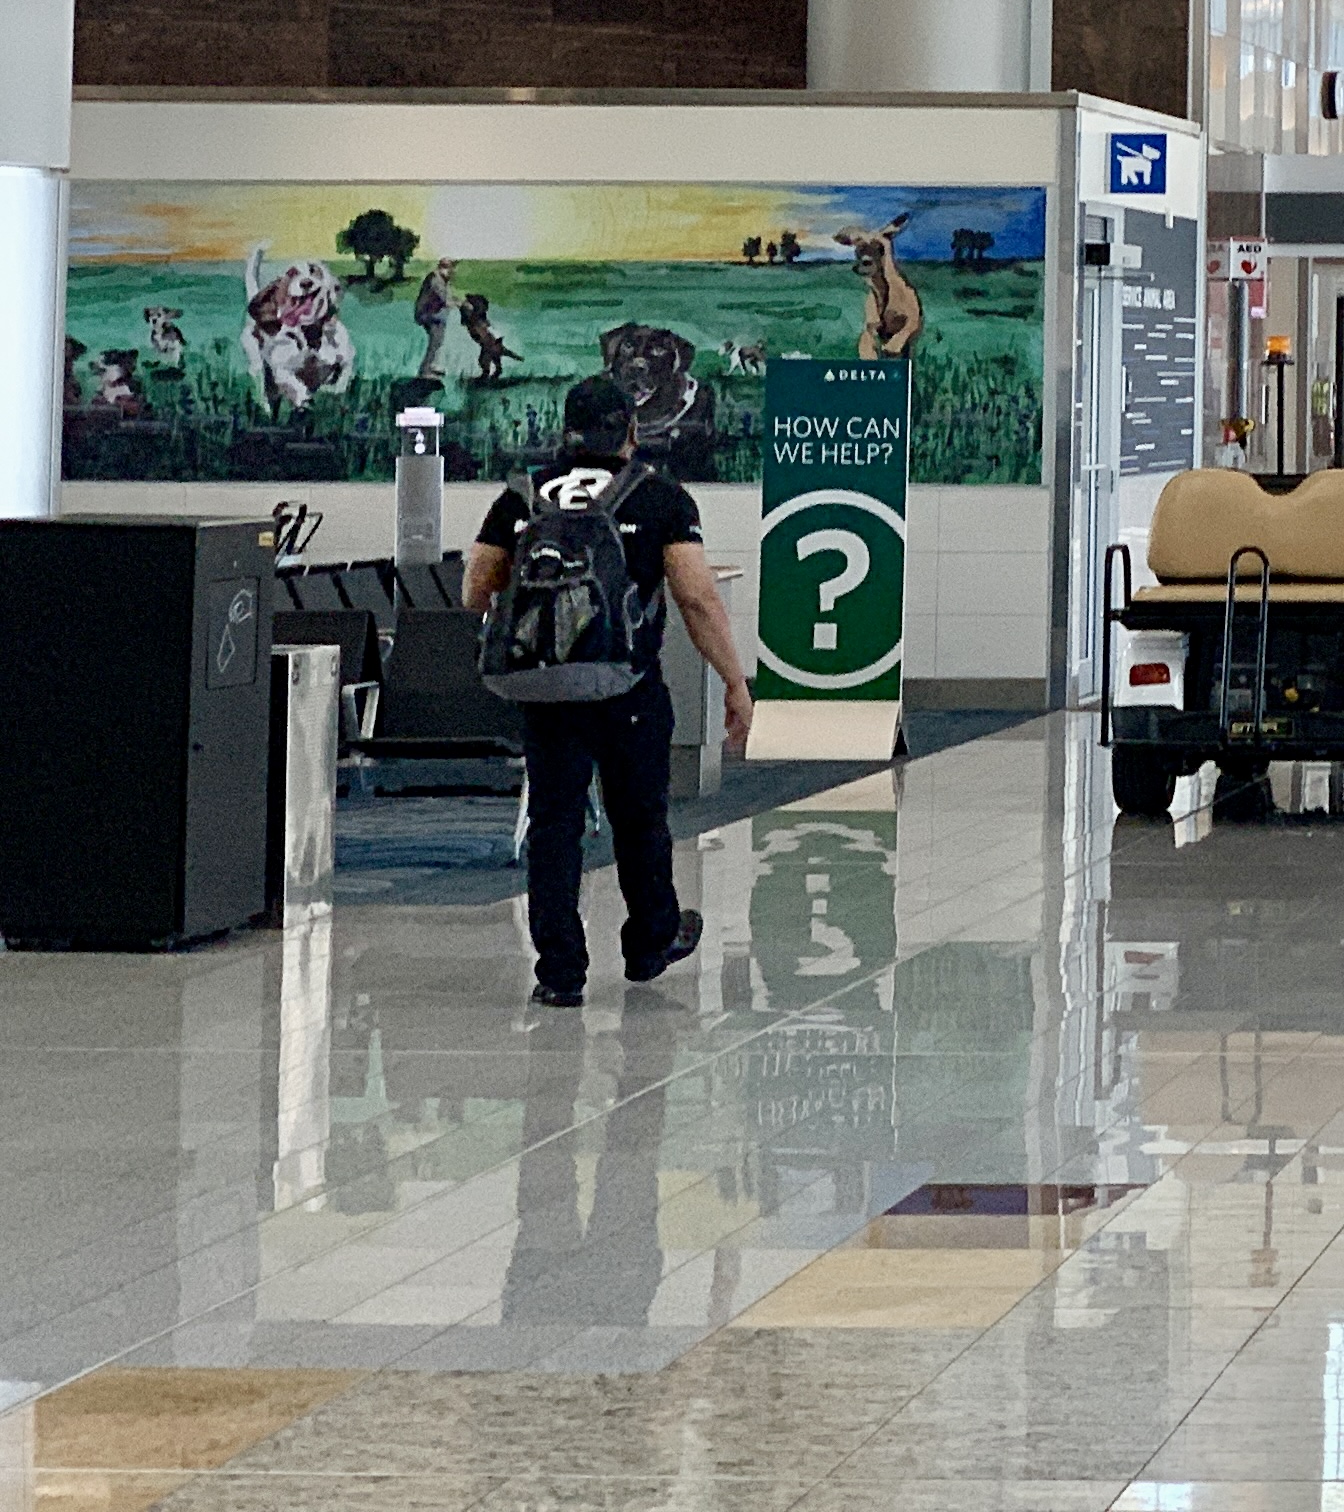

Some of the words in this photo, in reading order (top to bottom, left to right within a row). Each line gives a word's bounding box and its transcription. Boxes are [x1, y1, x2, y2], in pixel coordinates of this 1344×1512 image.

[1237, 243, 1262, 254] AED
[838, 369, 886, 382] DELTA
[774, 416, 840, 439] HOW
[846, 415, 900, 440] CAN
[774, 443, 814, 465] WE
[821, 441, 894, 465] HELP?
